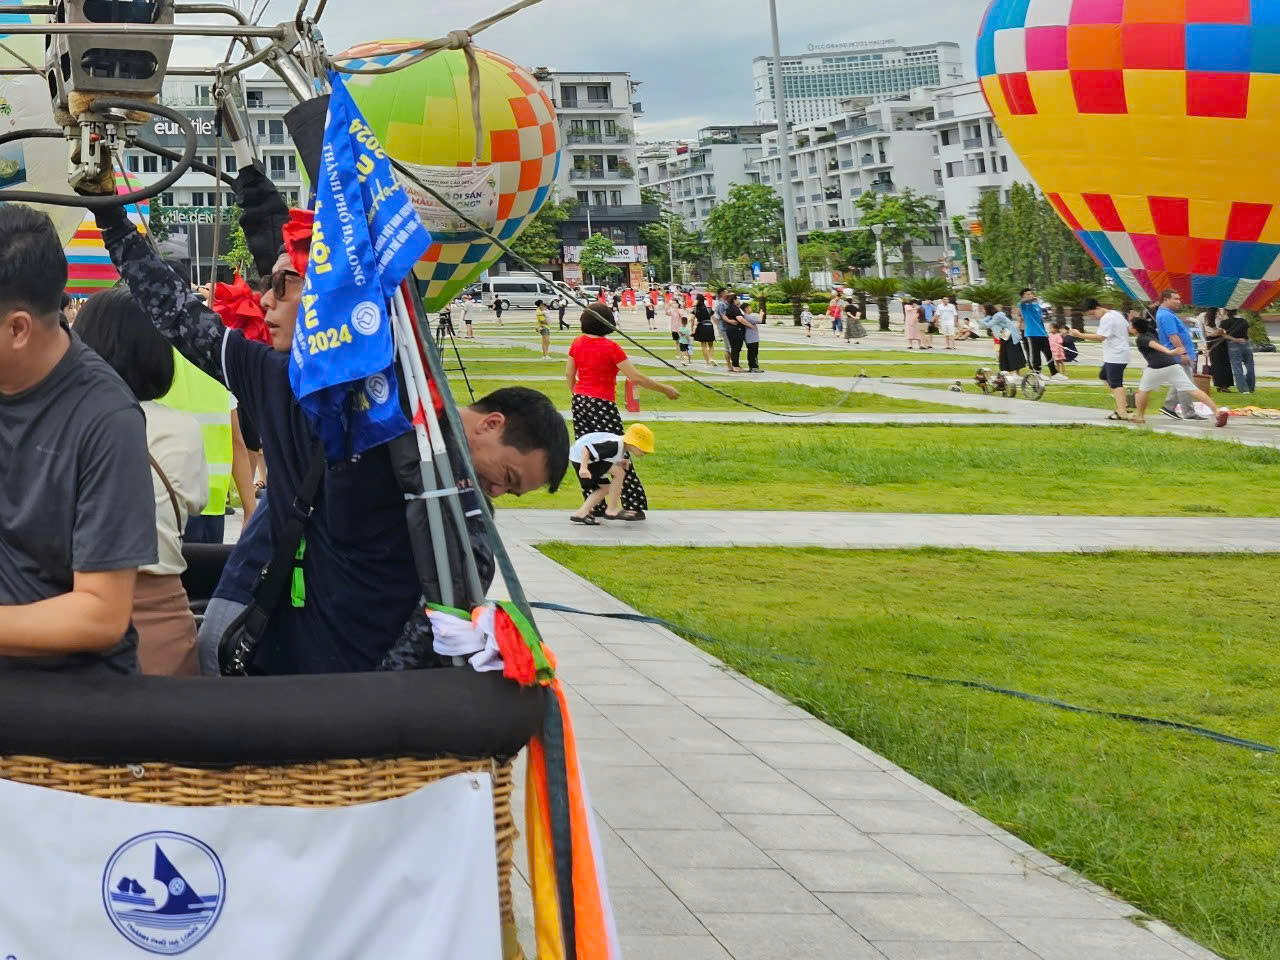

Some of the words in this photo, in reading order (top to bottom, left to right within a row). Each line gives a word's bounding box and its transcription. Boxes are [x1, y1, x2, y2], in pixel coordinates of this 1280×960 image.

[154, 117, 212, 135] eurtile
[348, 118, 385, 159] 2024
[453, 192, 463, 200] DI
[323, 141, 342, 192] THÀNH
[333, 192, 355, 223] PHỐ
[345, 245, 366, 286] LONG
[307, 323, 353, 356] 2024
